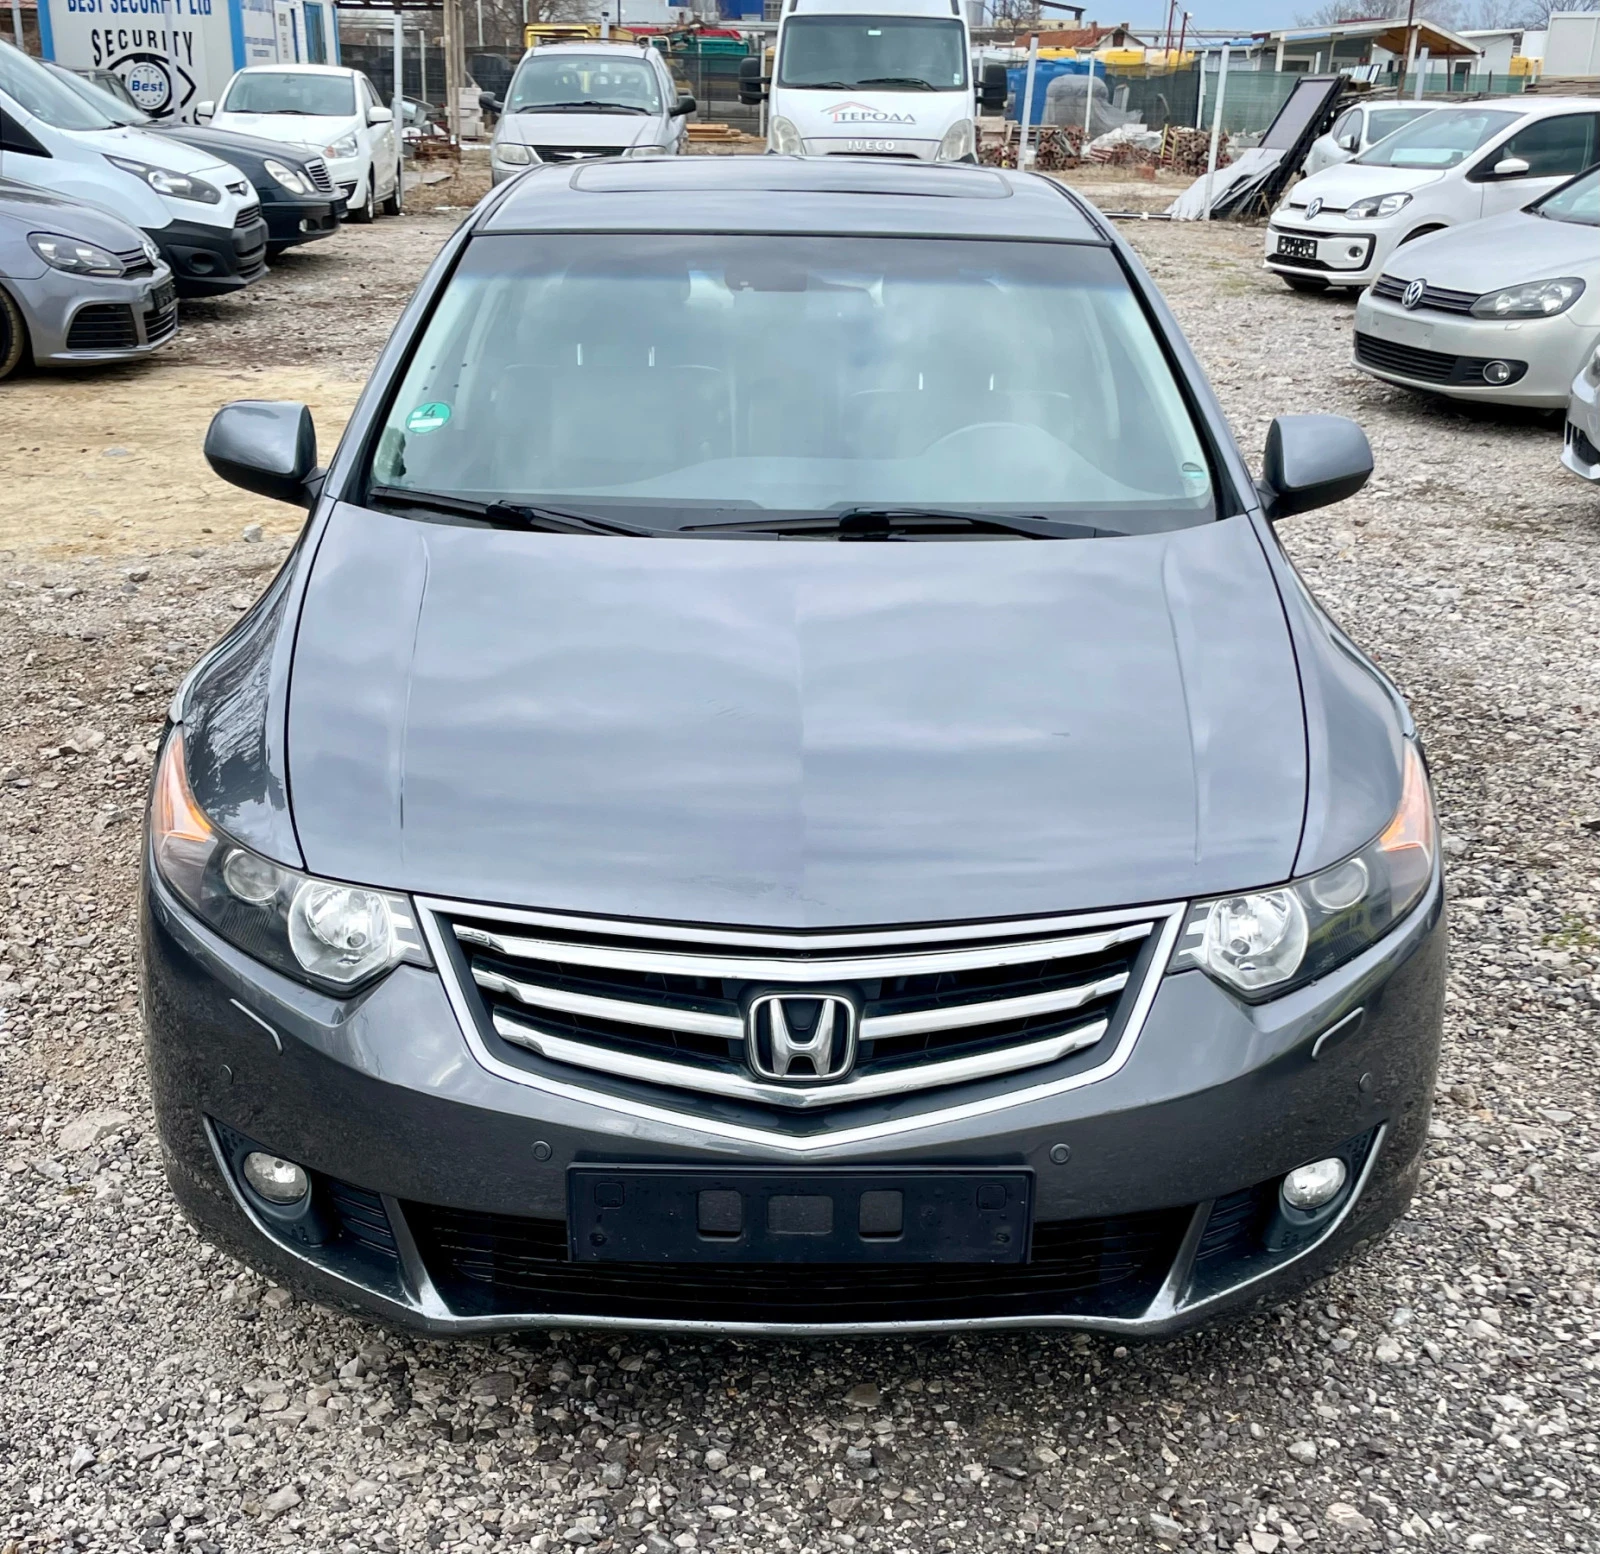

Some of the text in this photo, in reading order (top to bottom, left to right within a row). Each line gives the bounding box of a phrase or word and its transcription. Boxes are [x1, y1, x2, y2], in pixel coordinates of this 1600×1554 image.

[110, 0, 182, 14] SECURIY
[91, 29, 193, 67] SECURITY
[132, 80, 164, 92] Best
[848, 140, 896, 151] IVECO
[422, 404, 437, 418] 4
